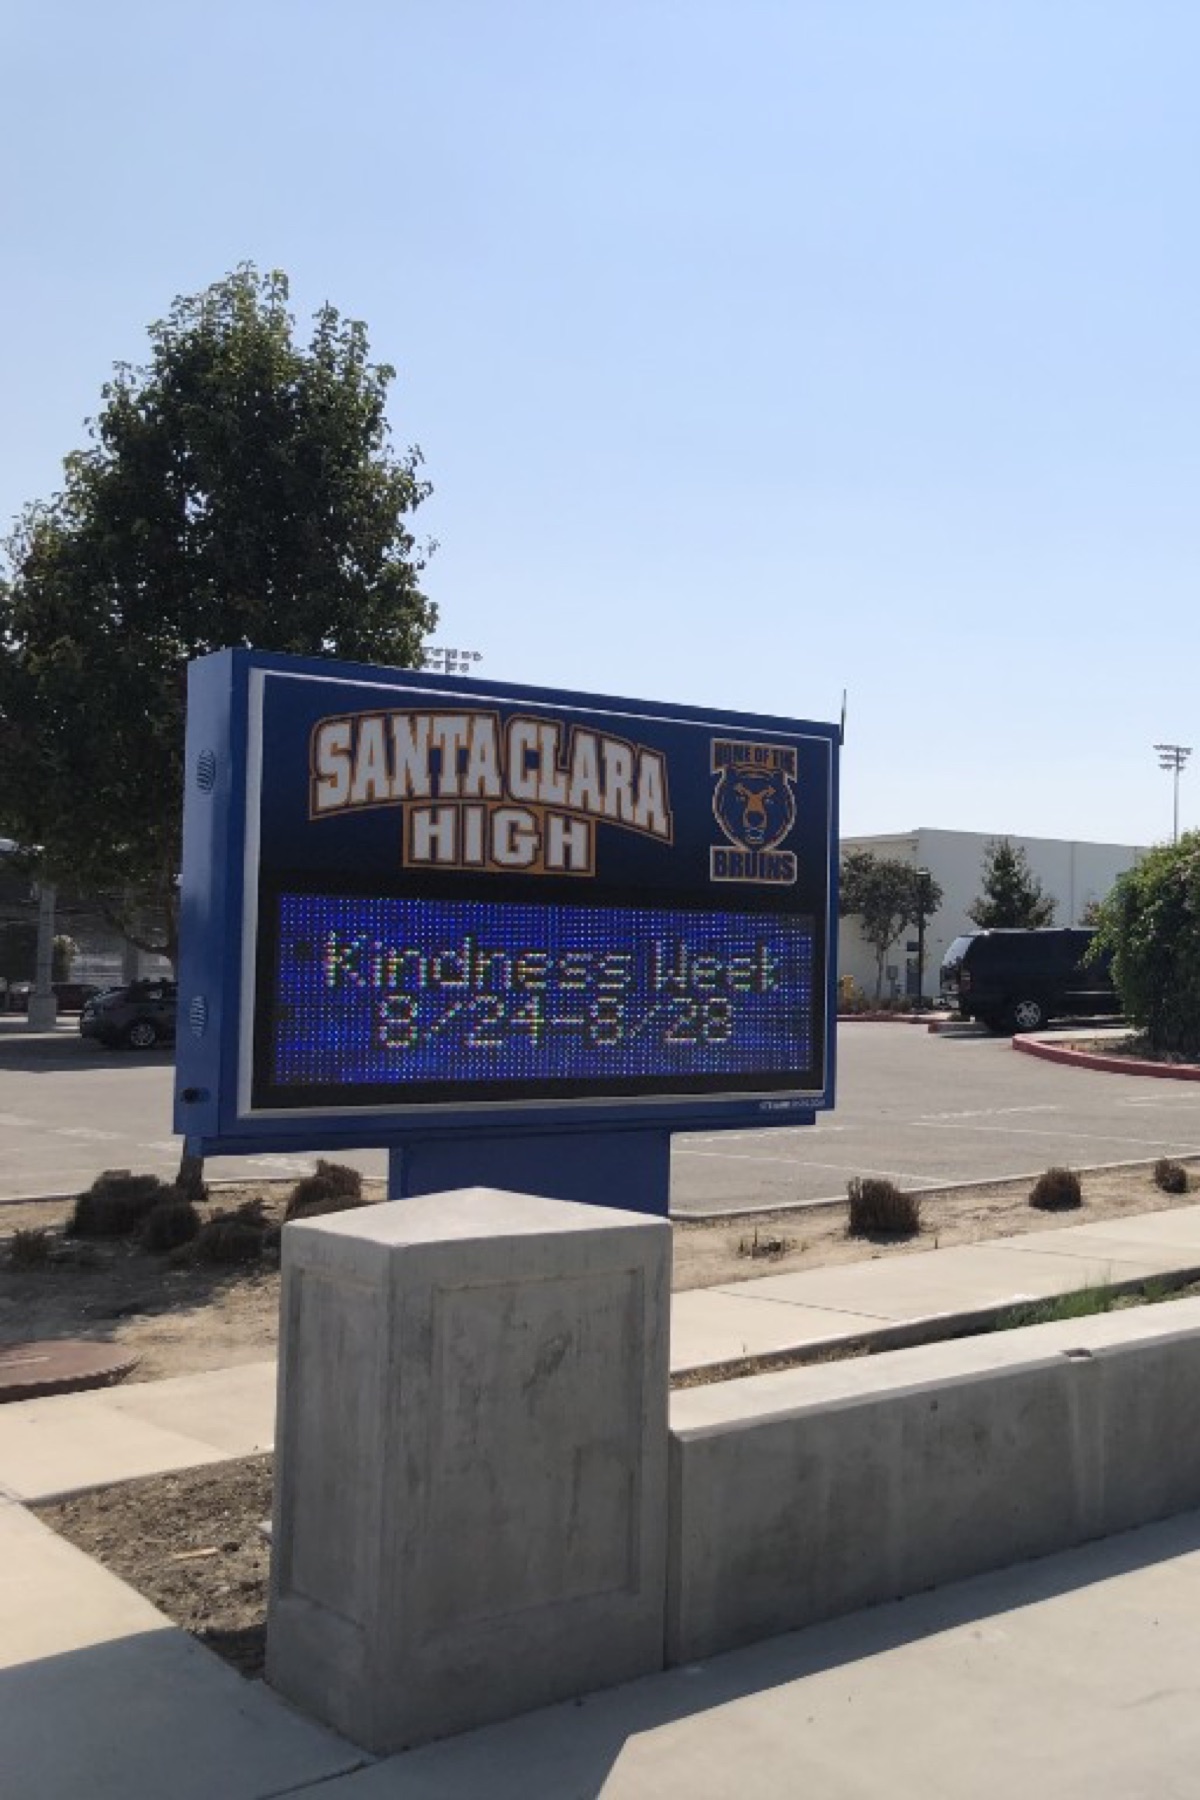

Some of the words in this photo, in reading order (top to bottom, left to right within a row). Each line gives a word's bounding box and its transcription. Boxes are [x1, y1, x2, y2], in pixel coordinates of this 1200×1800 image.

[312, 711, 502, 818] SANTA
[505, 714, 672, 842] CLARA
[407, 803, 592, 873] HIGH
[713, 849, 796, 881] BRUINS
[326, 930, 633, 988] Kindness
[654, 938, 780, 992] Week
[380, 995, 733, 1048] 8/24-8/28
